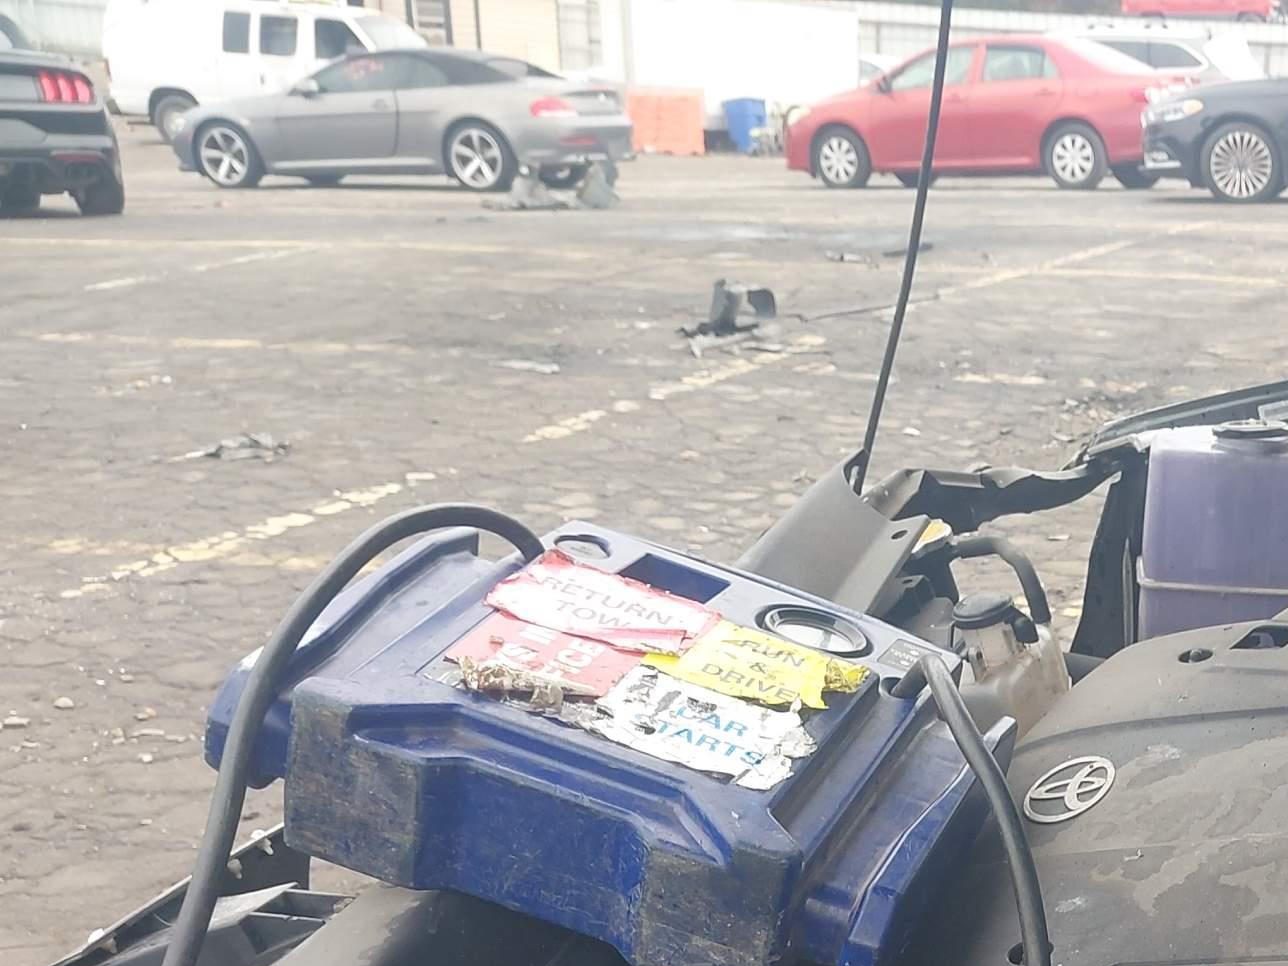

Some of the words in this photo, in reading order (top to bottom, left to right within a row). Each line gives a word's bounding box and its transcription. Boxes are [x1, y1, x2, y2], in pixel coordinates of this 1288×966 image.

[542, 577, 673, 625] RETURN
[556, 600, 631, 627] TOW
[701, 663, 797, 700] DRIVE
